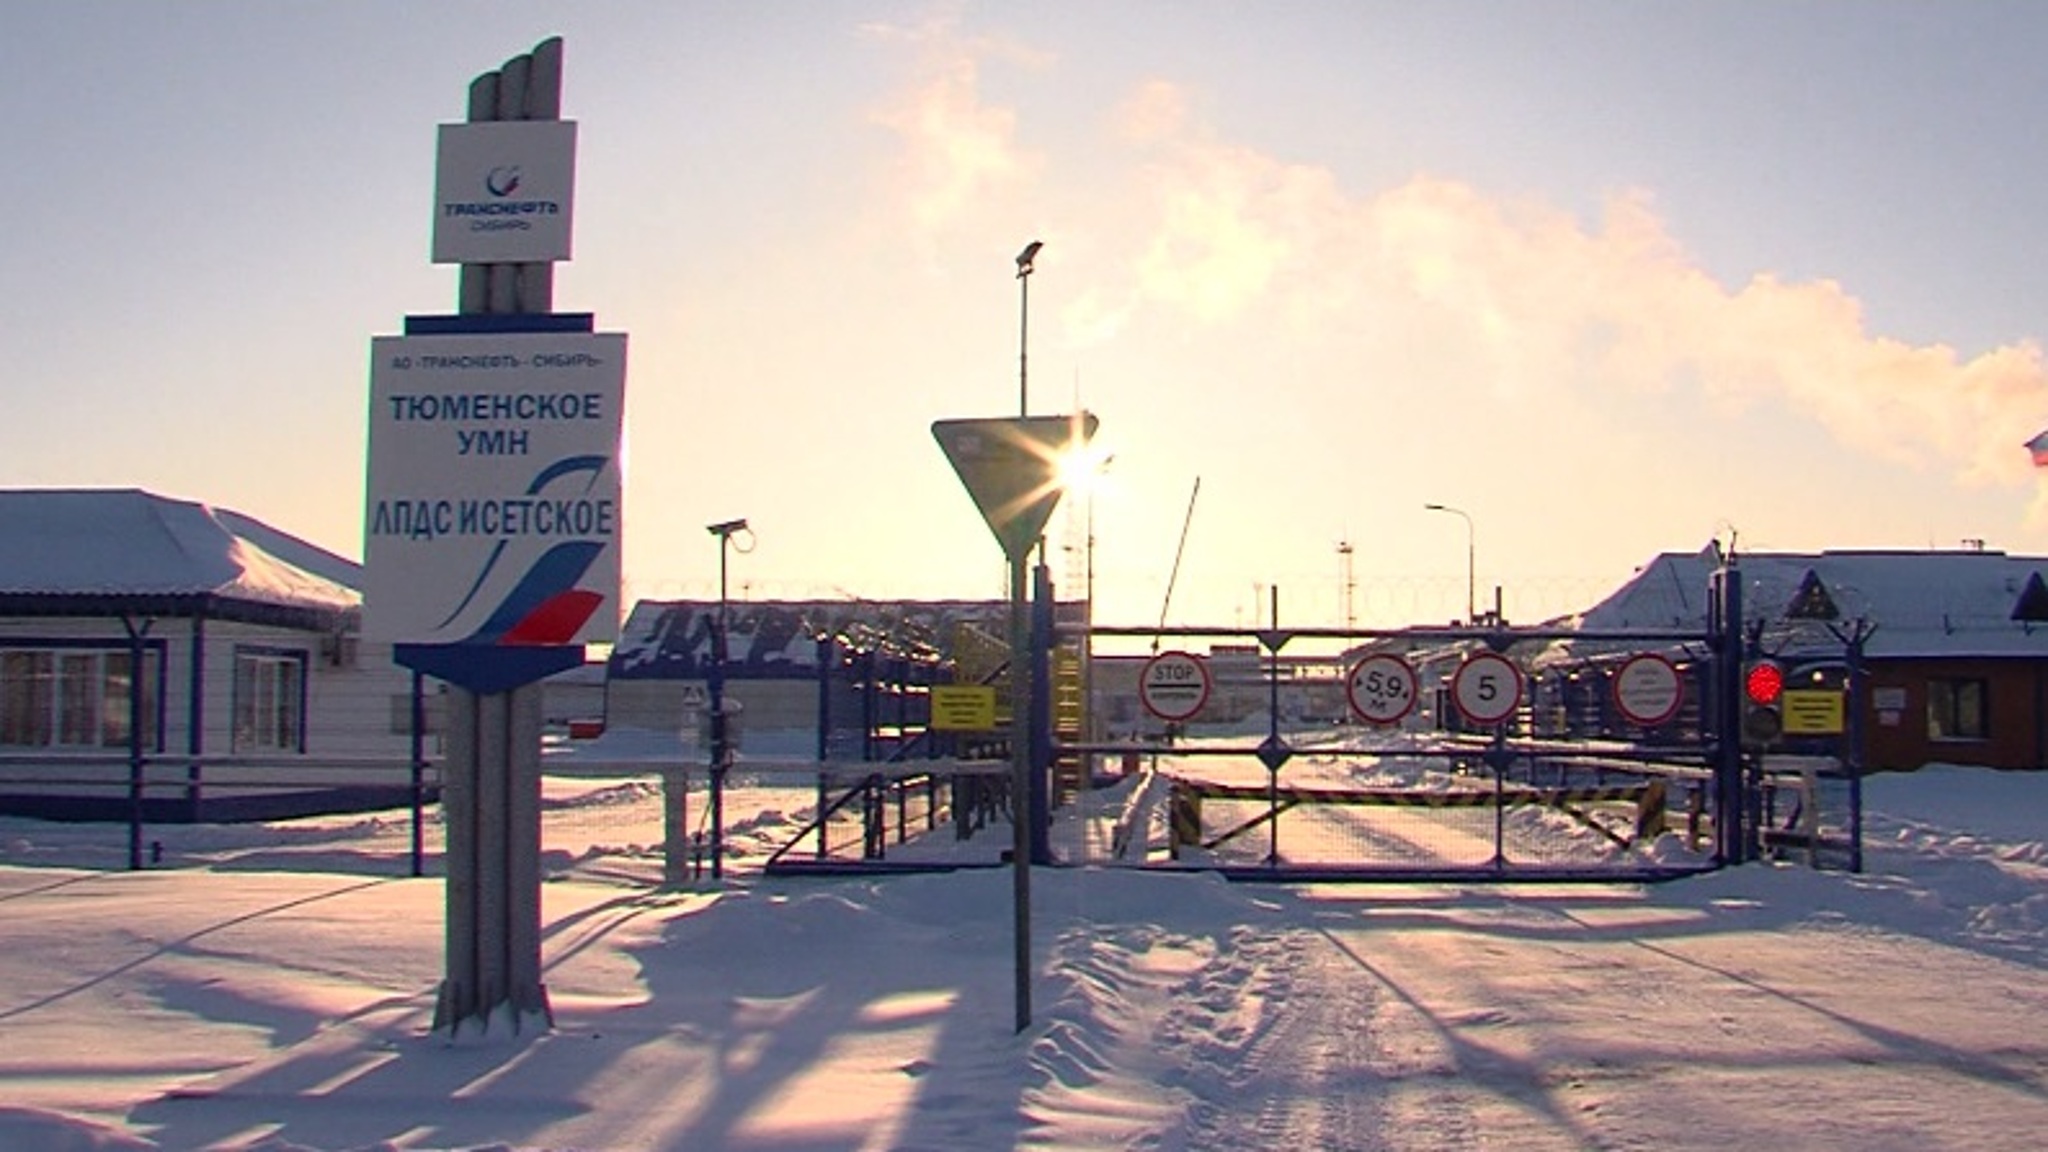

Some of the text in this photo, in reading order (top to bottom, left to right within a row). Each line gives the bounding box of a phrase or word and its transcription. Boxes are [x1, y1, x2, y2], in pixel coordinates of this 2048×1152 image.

[444, 202, 558, 215] ТРАНСНЕФТЬ
[393, 357, 411, 369] АО
[390, 394, 602, 420] ТЮМЕНСКОЕ
[457, 430, 529, 455] УМН
[373, 500, 613, 540] ЛПДС ИСЕТСКОЕ
[1155, 664, 1195, 680] STOP
[1477, 676, 1497, 700] 5
